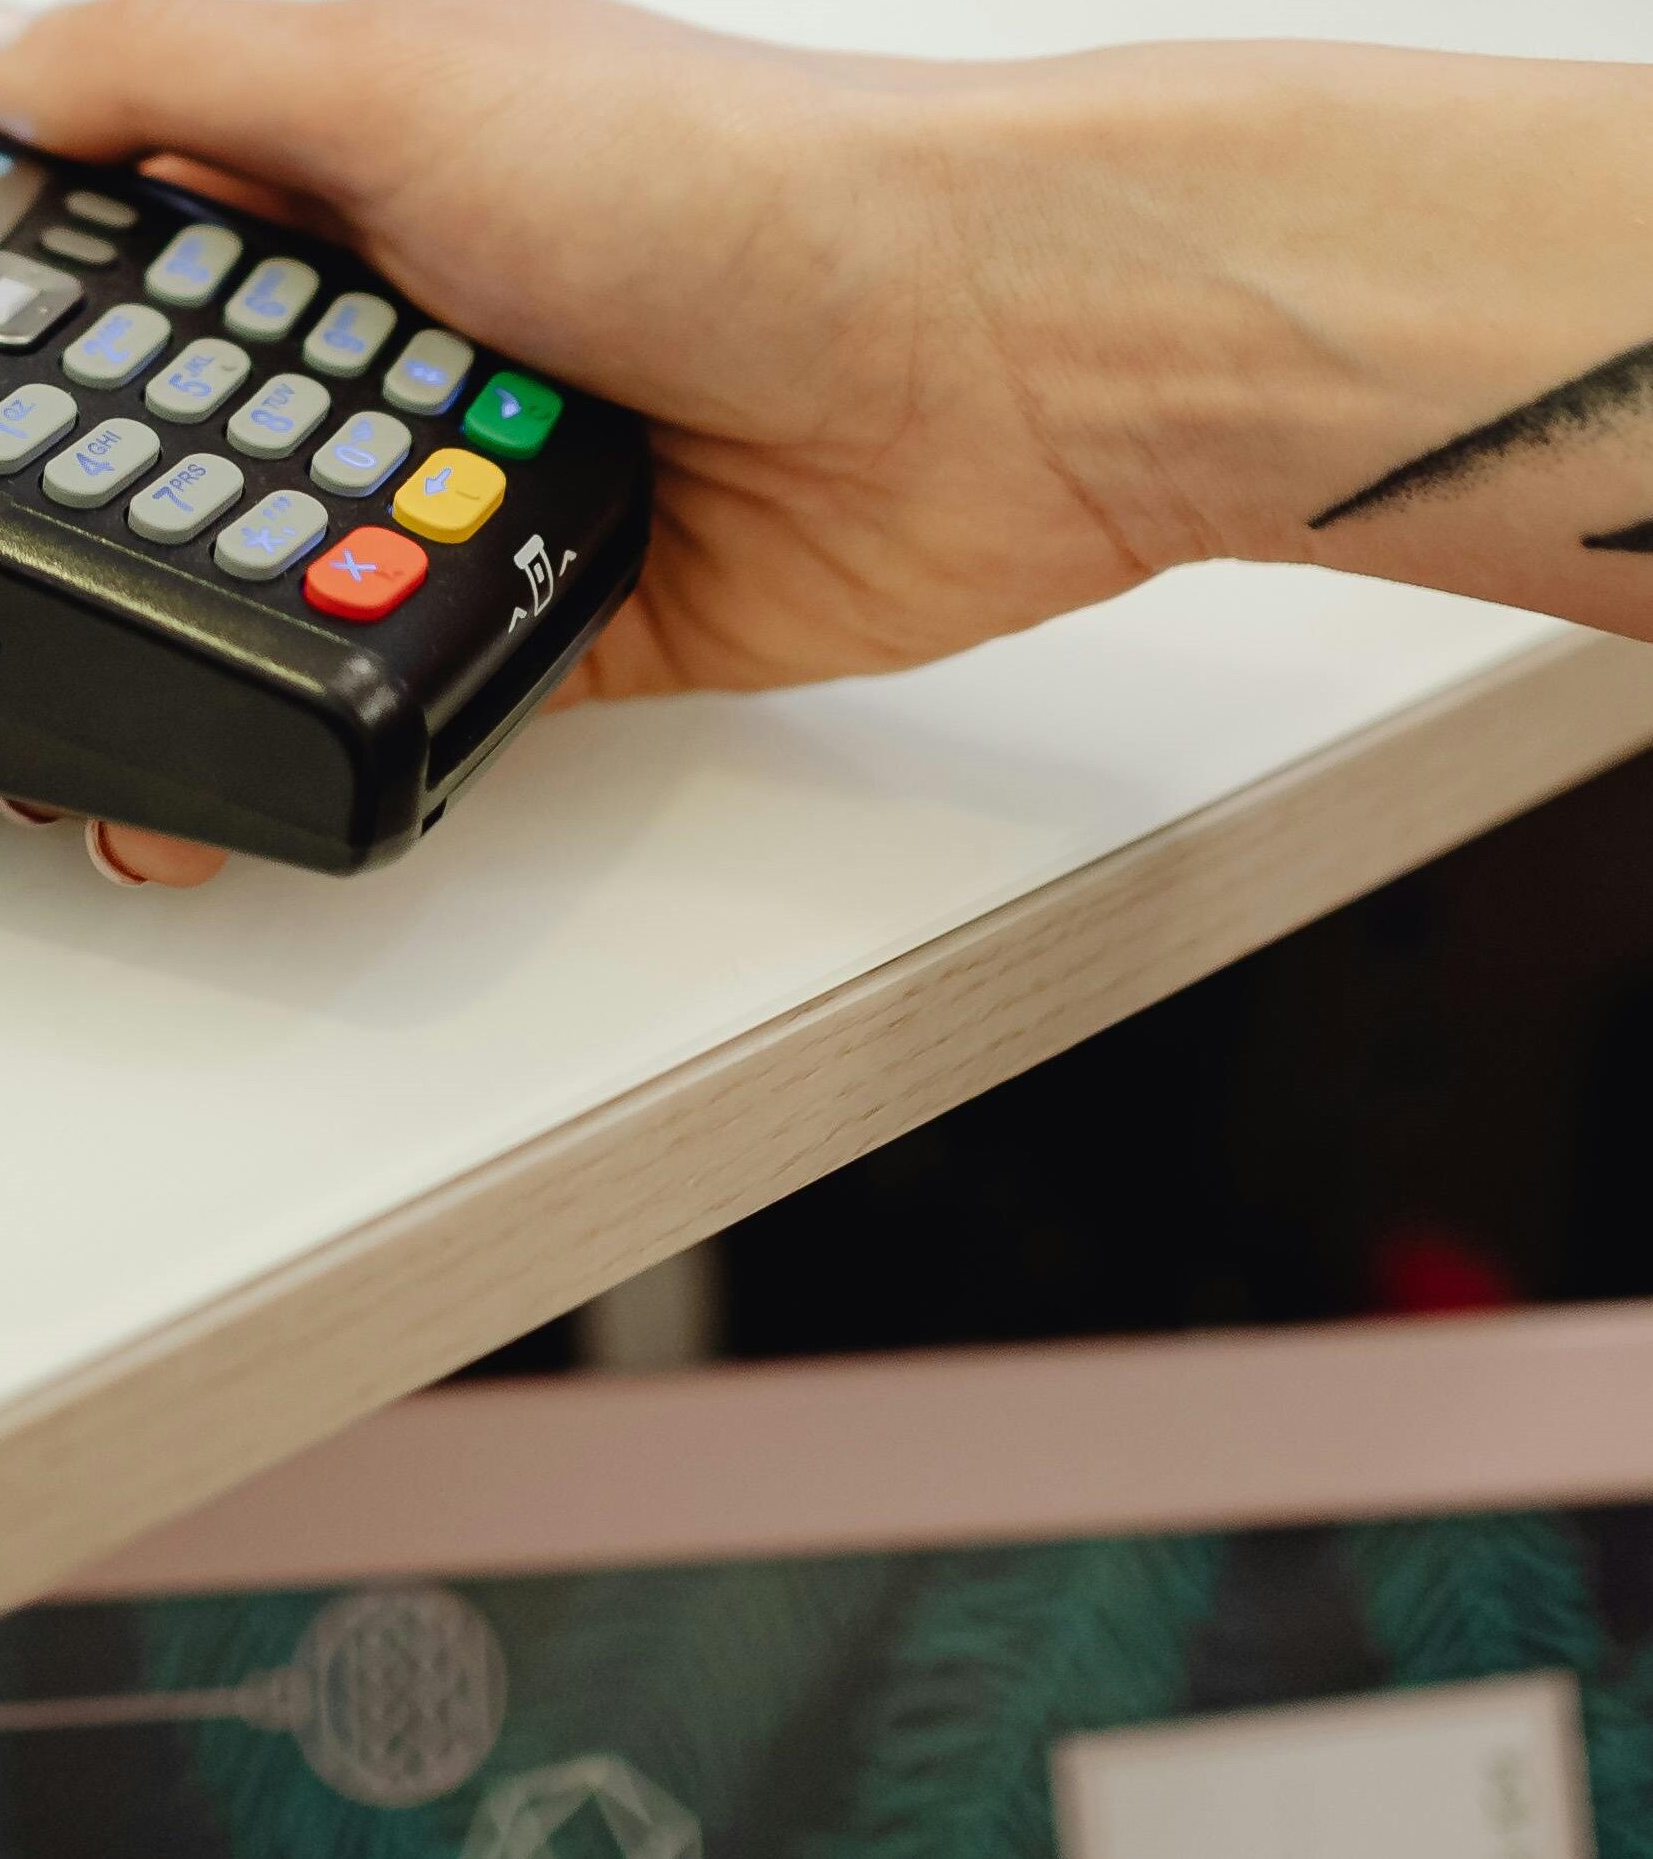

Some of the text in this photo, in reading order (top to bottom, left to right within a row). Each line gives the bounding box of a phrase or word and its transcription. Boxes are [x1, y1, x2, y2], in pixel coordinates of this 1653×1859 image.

[168, 372, 213, 397] 5
[251, 408, 295, 434] 8
[76, 429, 123, 476] 4 GHI
[333, 444, 379, 470] 0
[152, 463, 207, 514] 7 PRS
